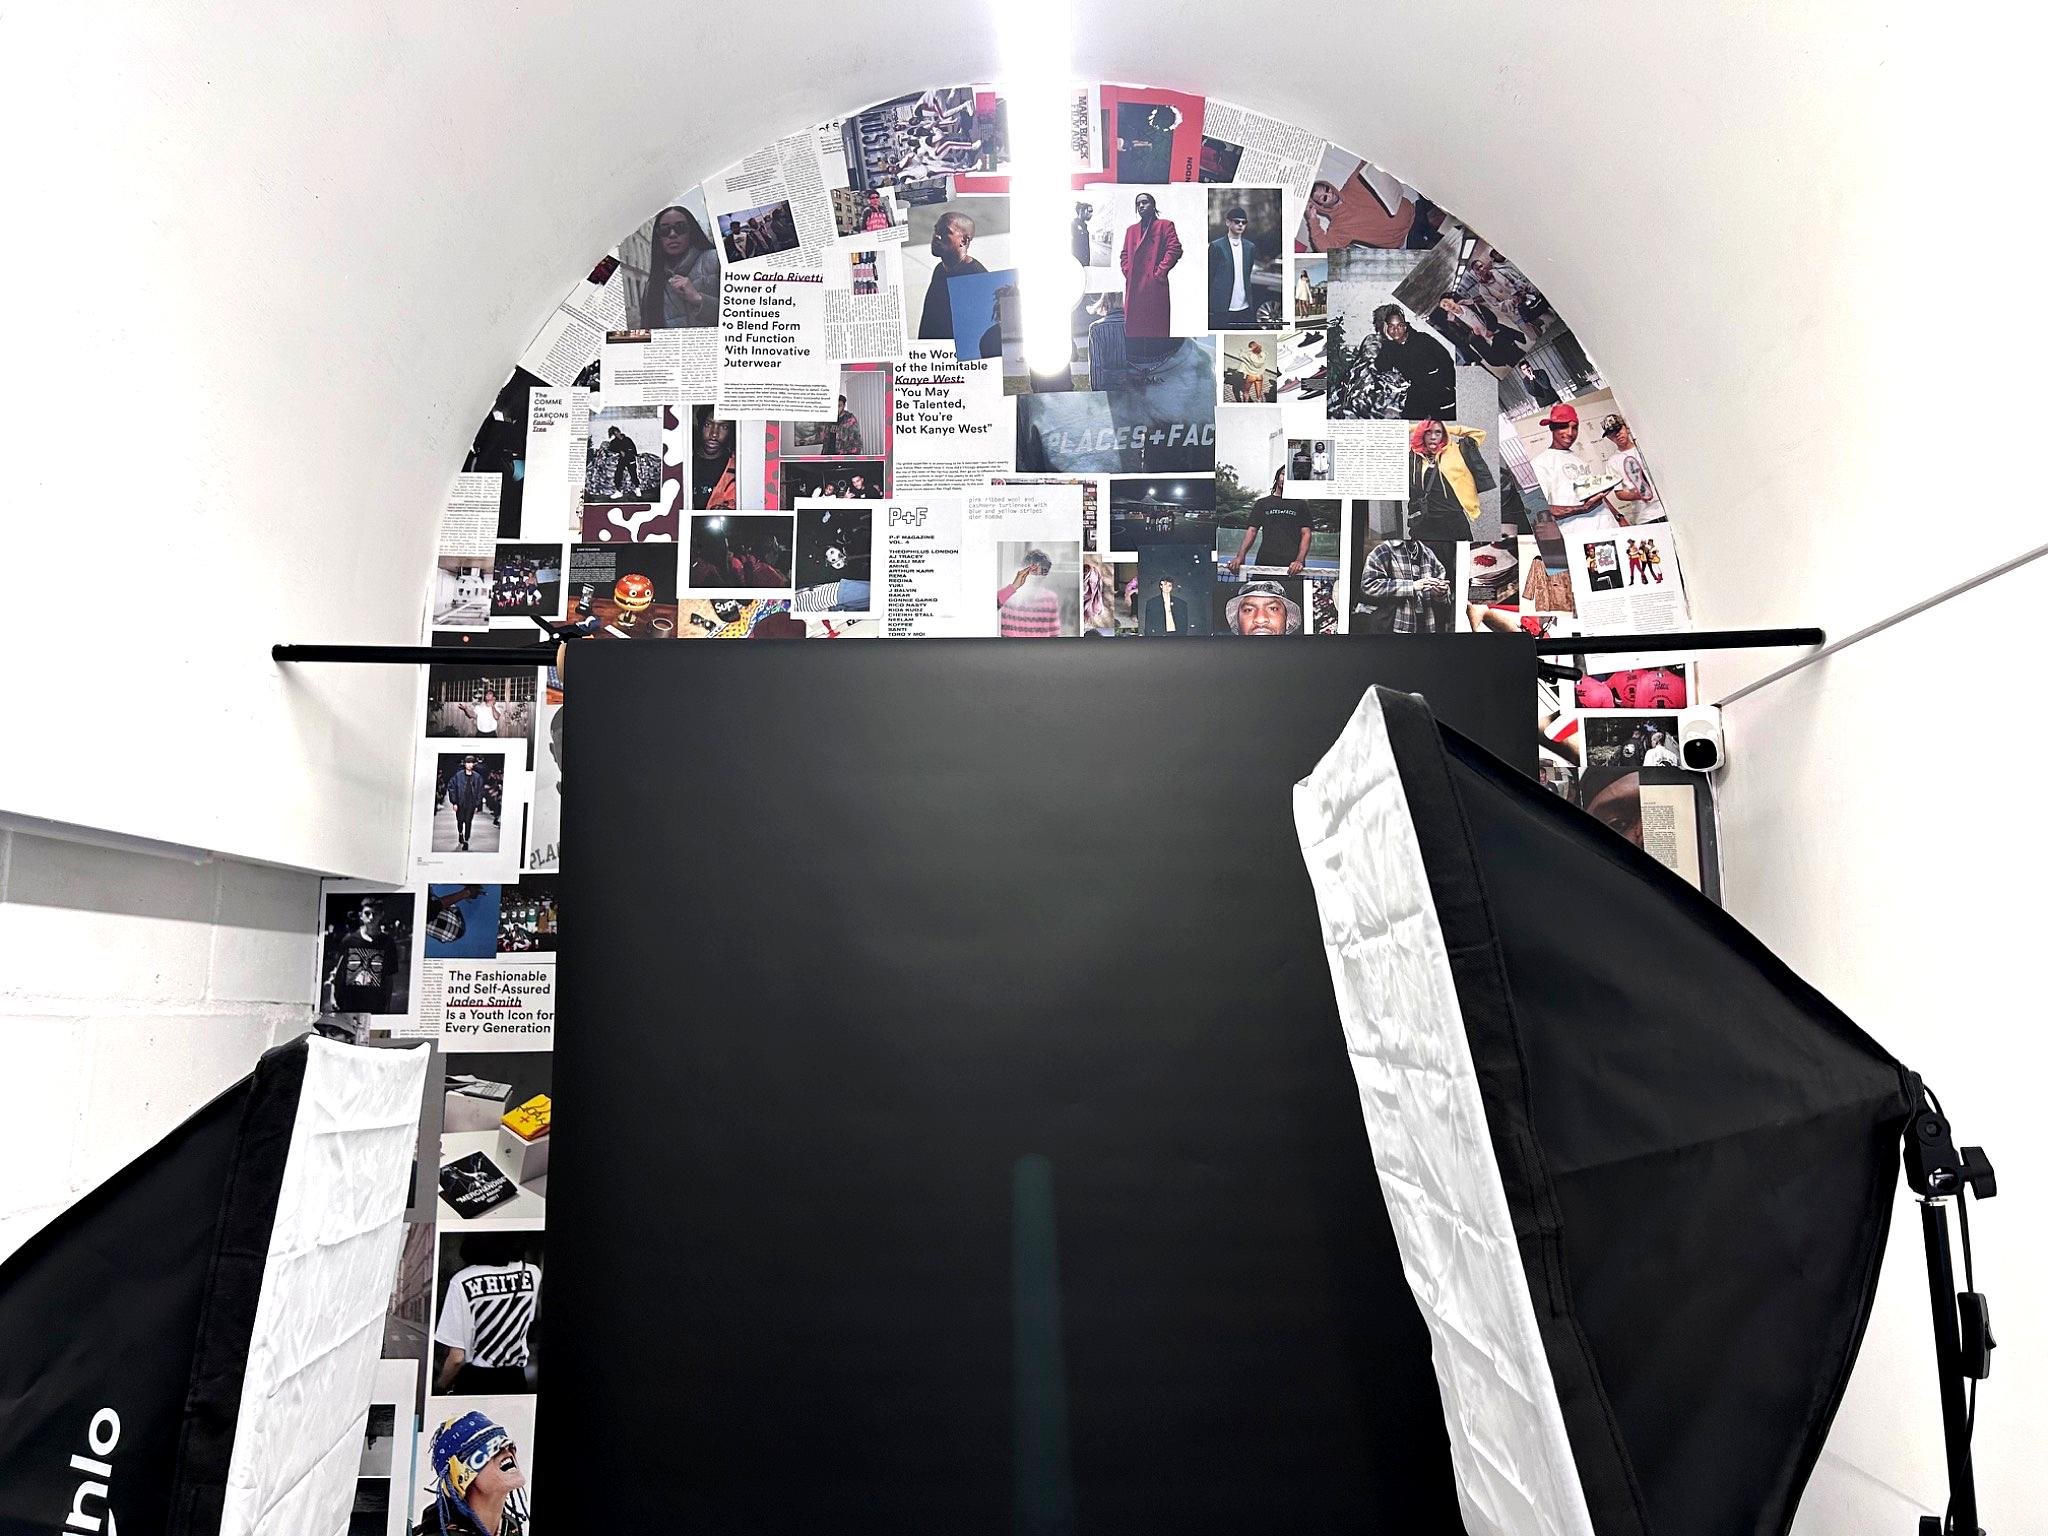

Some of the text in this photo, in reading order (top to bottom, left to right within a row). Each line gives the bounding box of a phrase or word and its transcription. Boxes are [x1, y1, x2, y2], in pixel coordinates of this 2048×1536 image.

[1079, 128, 1088, 159] BLACK
[725, 272, 823, 283] How Carlo Rivetti
[724, 284, 776, 293] Owner of
[724, 296, 796, 307] Stone Island,
[723, 308, 780, 318] Continues
[737, 321, 768, 330] Blend
[772, 322, 800, 330] Form
[746, 334, 795, 343] Function
[752, 346, 810, 356] Innovative
[908, 350, 927, 359] the
[895, 361, 988, 372] of the Inimitable
[895, 375, 965, 386] Kanye West:
[925, 388, 950, 398] May
[896, 399, 966, 410] Be Talented,
[896, 412, 914, 422] But
[896, 425, 917, 434] Not
[920, 425, 955, 436] Kanye
[888, 507, 928, 526] P+F
[449, 970, 547, 981] The Fashionable
[448, 984, 550, 994] and Self-Assured
[447, 997, 522, 1007] Jaden Smith
[446, 1010, 455, 1020] Is
[470, 1010, 504, 1020] Youth
[508, 1010, 533, 1020] Icon
[537, 1010, 554, 1020] for
[446, 1022, 479, 1035] Every
[483, 1022, 551, 1033] Generation
[464, 1272, 532, 1298] WHITE
